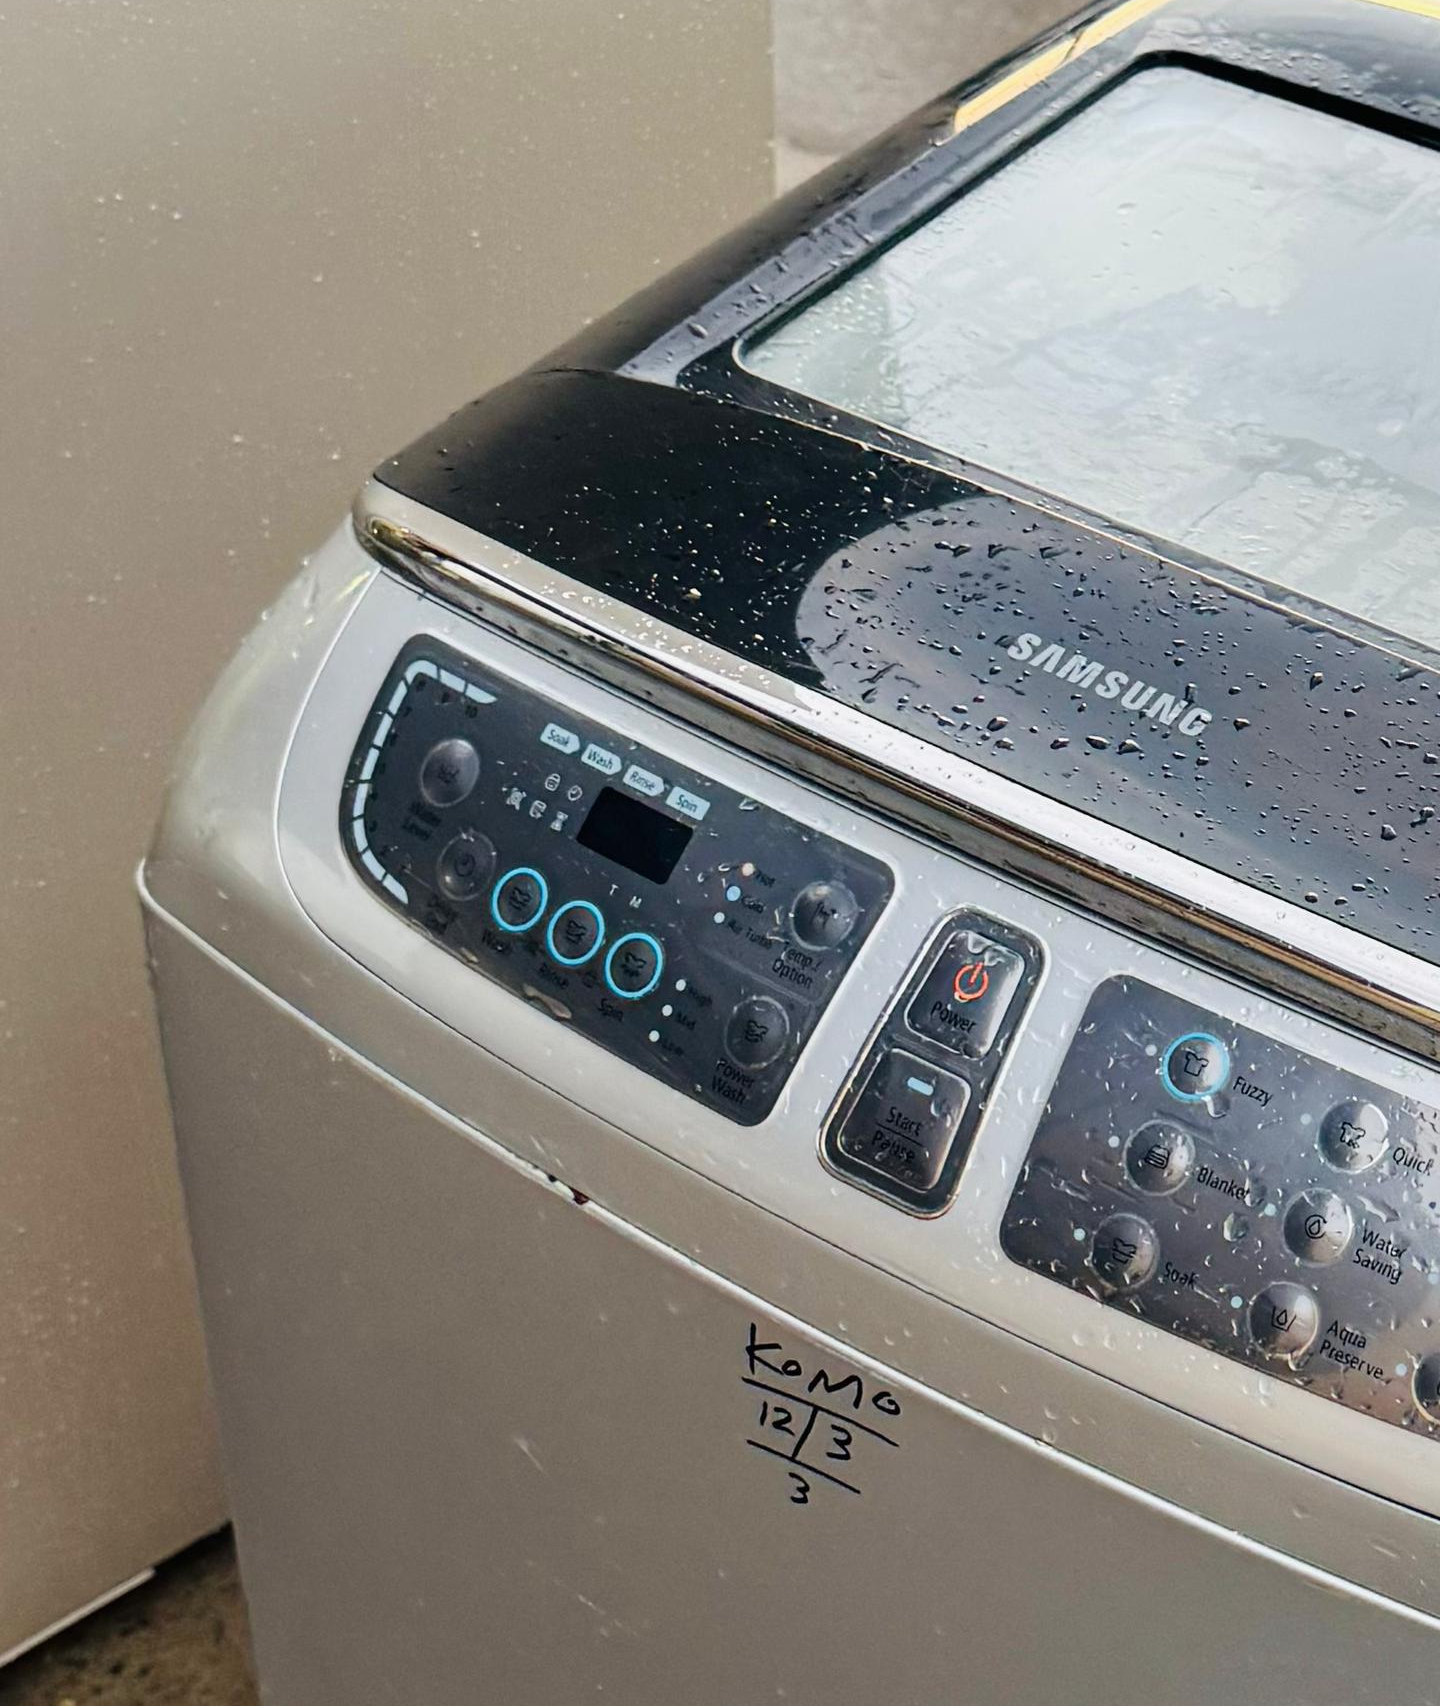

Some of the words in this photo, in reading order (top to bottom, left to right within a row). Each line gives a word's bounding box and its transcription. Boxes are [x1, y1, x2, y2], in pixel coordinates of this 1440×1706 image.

[1007, 632, 1213, 737] SAMSUNG
[547, 729, 570, 748] Soak
[587, 748, 614, 771] Wash
[630, 771, 656, 791] Rinse
[675, 794, 699, 814] Spin
[772, 958, 815, 990] Option
[597, 997, 625, 1023] Spin
[930, 1000, 978, 1035] Power
[715, 1057, 756, 1090] Power
[711, 1076, 748, 1107] Wash
[1233, 1076, 1274, 1107] Fuzzy
[885, 1106, 924, 1138] Start
[871, 1129, 916, 1163] Pause
[1391, 1146, 1435, 1177] Quick
[1196, 1166, 1252, 1202] Blanket
[1361, 1225, 1406, 1259] Water
[1163, 1262, 1199, 1290] Soak
[1352, 1248, 1403, 1286] Saving
[1326, 1319, 1368, 1351] Aqua
[1319, 1342, 1386, 1381] Preserve
[787, 1471, 812, 1505] 3
